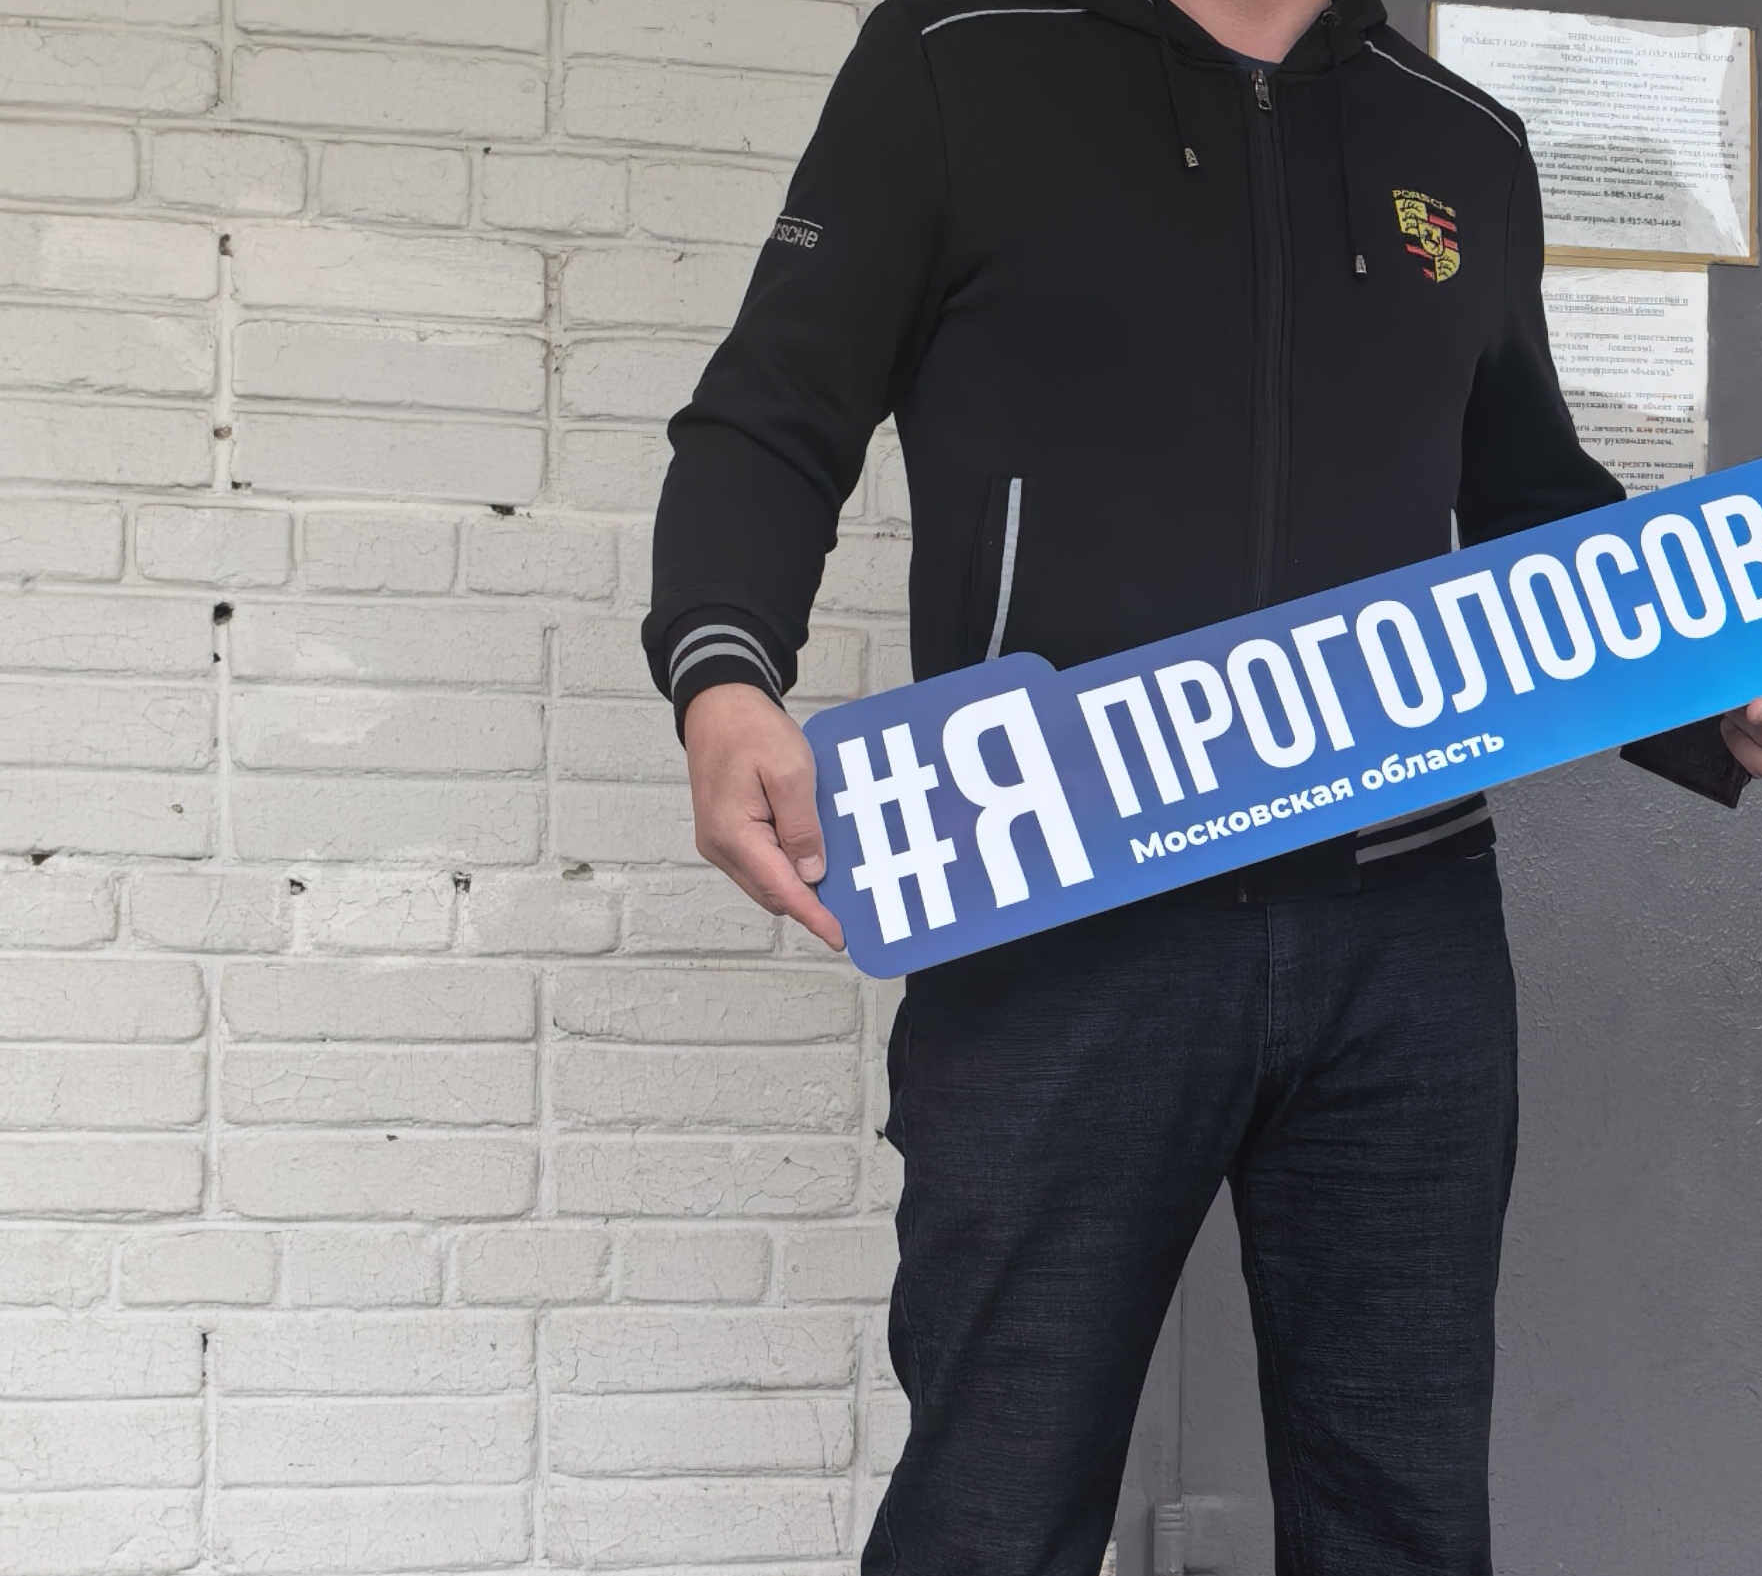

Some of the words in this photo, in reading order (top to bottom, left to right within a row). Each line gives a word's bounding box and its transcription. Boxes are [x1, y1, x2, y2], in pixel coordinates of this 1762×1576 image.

[833, 686, 1096, 946] #Я
[1129, 778, 1355, 865] Московская
[1360, 727, 1506, 792] область
